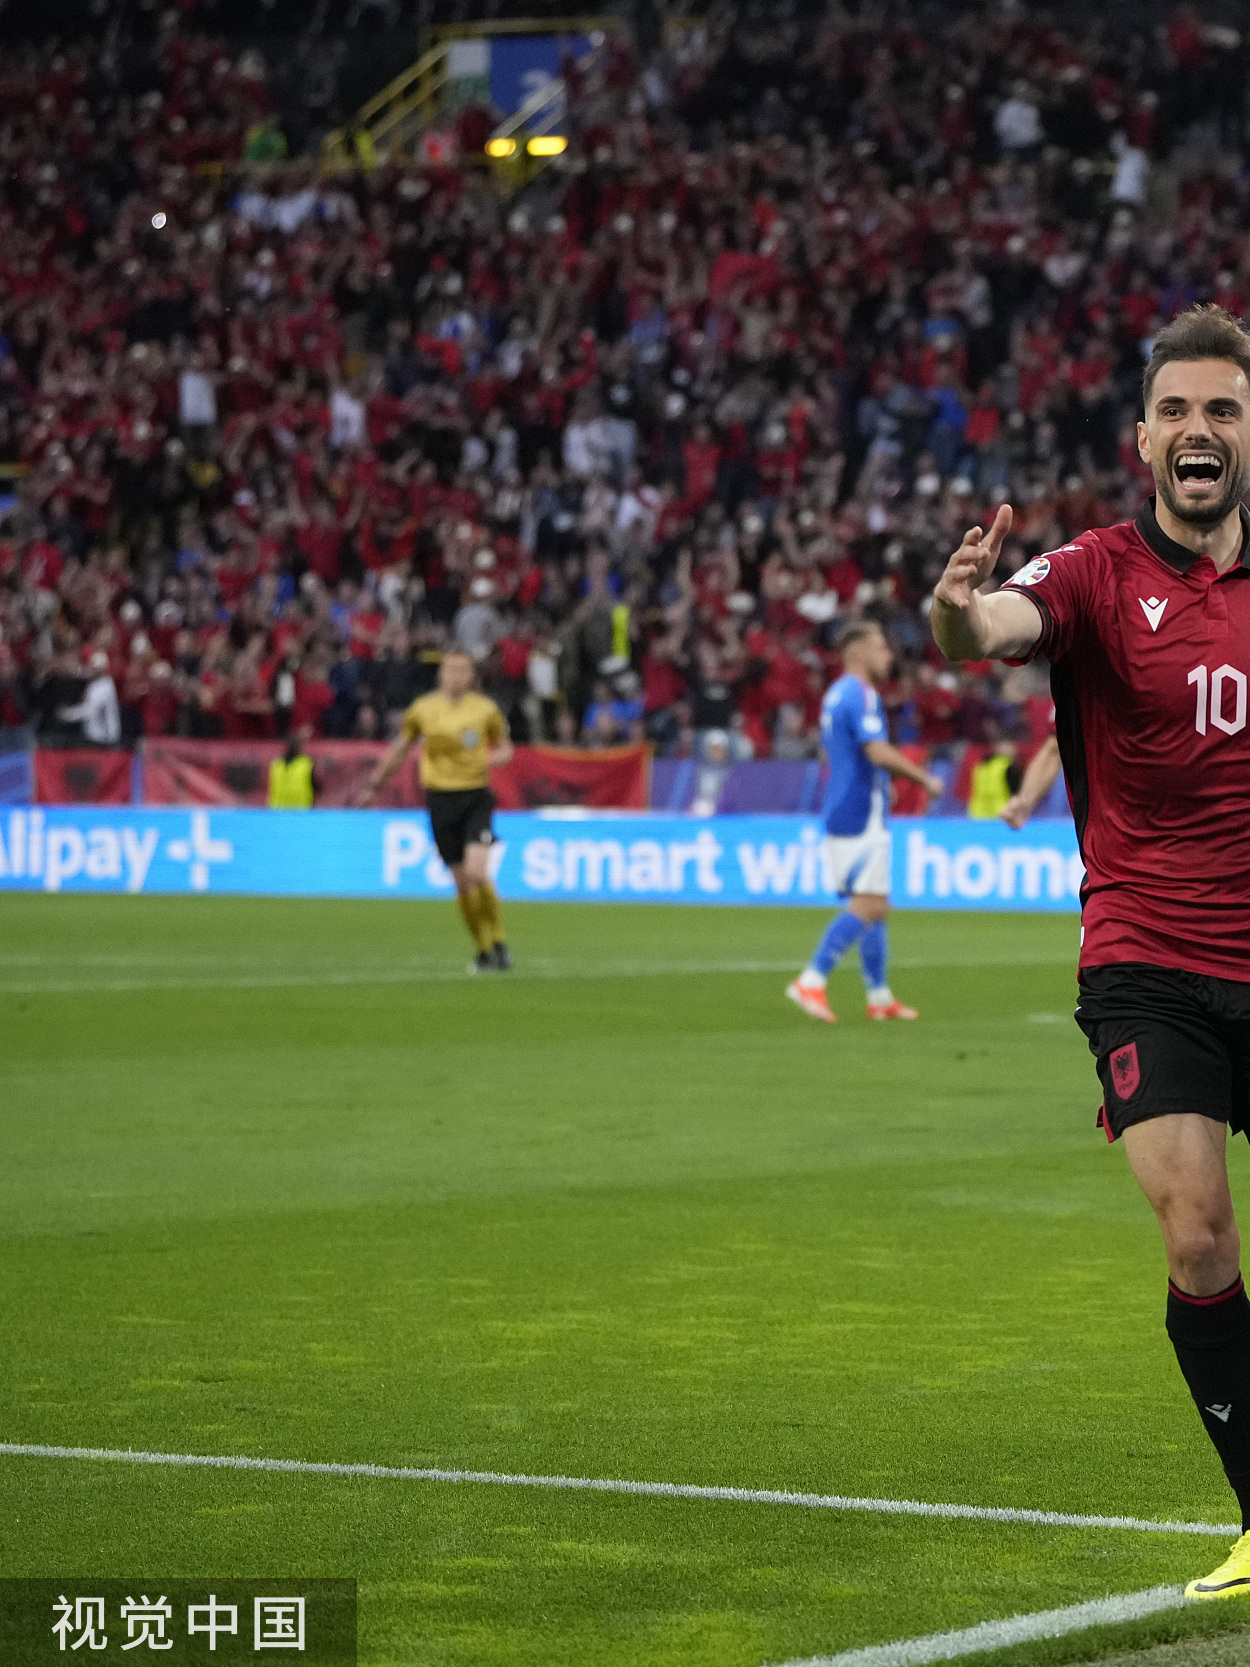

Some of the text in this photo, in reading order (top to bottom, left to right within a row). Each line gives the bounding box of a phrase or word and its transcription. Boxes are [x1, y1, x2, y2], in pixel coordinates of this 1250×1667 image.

[1187, 663, 1247, 736] 10
[522, 829, 723, 892] smart
[738, 827, 845, 895] wi
[905, 829, 1086, 900] hom
